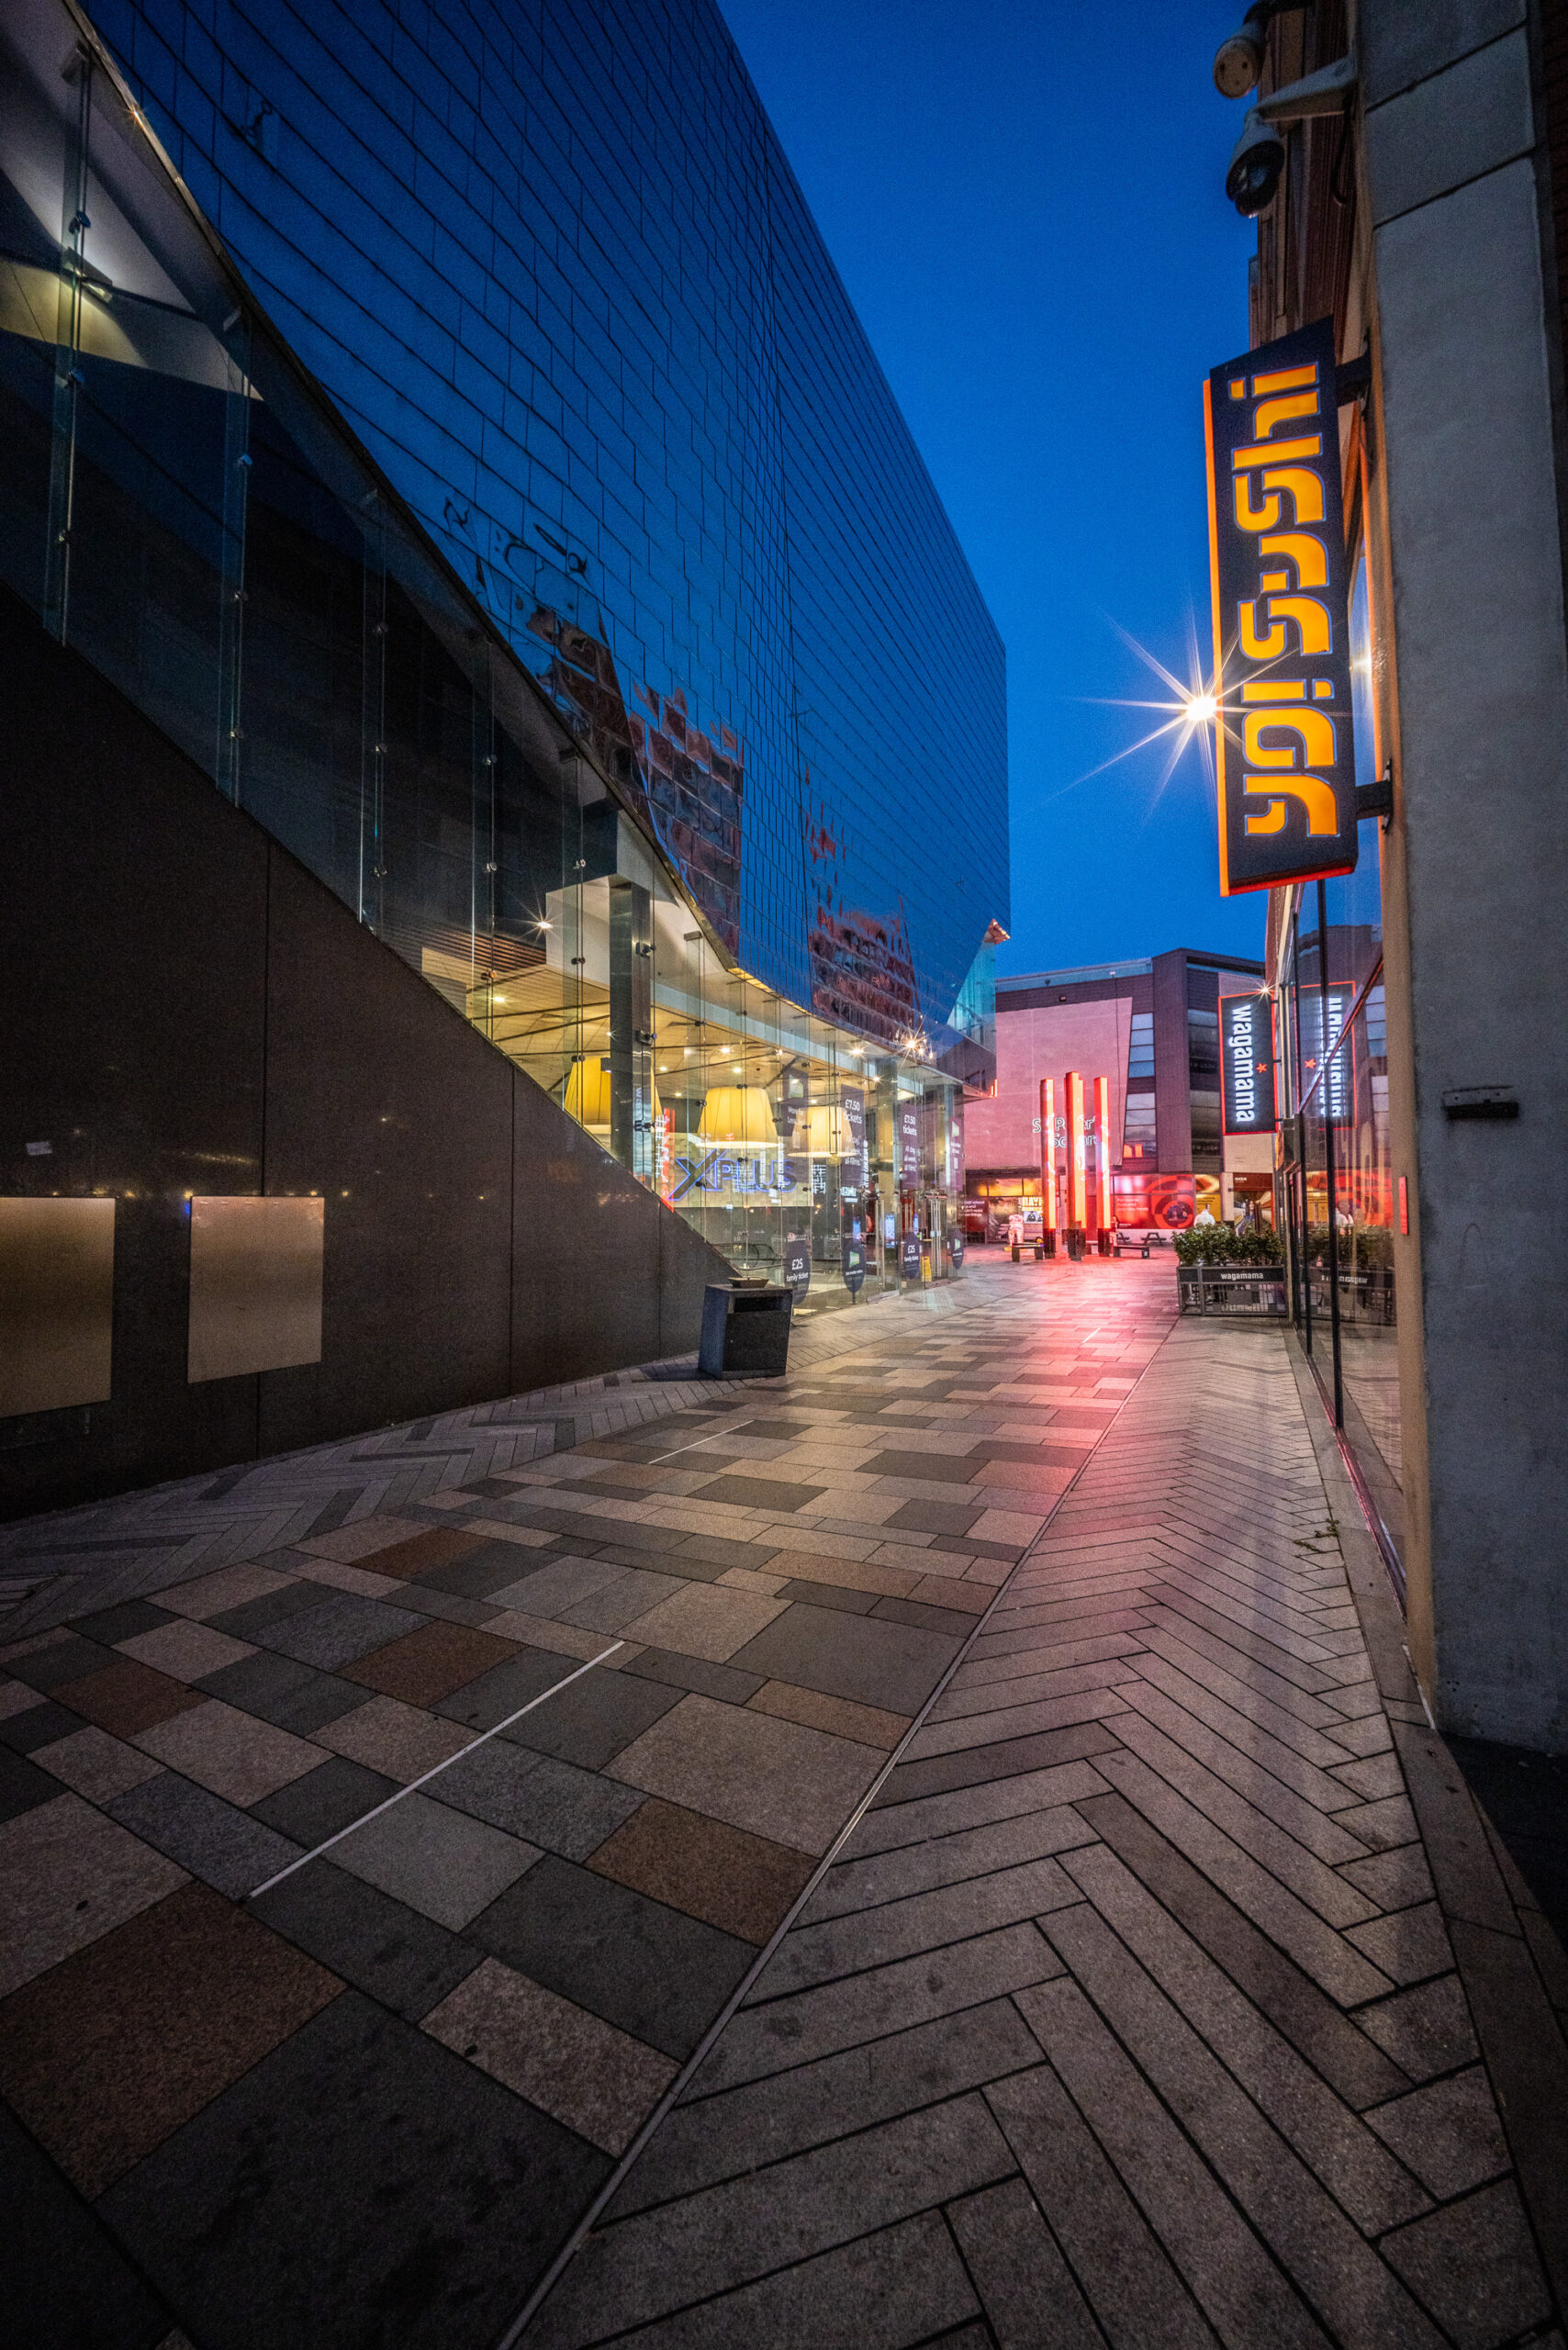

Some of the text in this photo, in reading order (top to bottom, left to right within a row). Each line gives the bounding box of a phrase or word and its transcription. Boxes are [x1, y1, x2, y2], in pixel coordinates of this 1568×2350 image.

[1228, 1004, 1255, 1123] wagamama
[667, 1147, 798, 1202] XPLUS
[791, 1258, 804, 1270] £25
[786, 1271, 809, 1282] family ticket
[1220, 1272, 1264, 1281] wagamama
